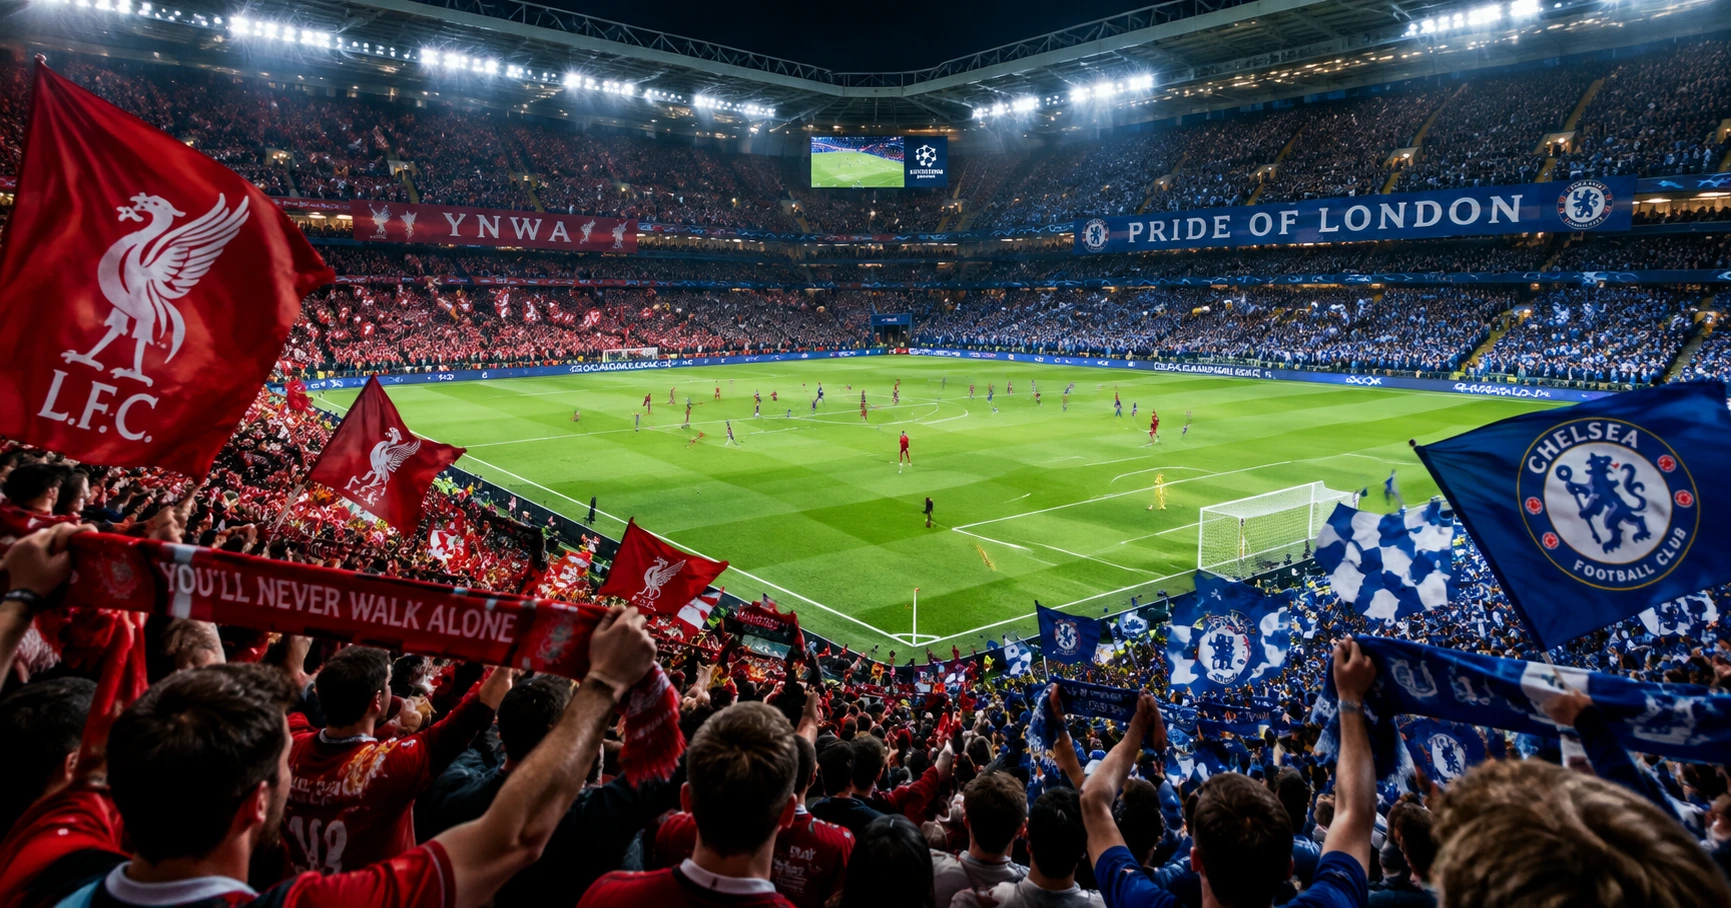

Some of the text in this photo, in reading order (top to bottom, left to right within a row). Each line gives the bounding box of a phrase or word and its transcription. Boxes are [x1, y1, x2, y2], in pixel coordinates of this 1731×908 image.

[443, 212, 572, 243] YNWA
[1128, 194, 1523, 243] PRIDE OF LONDON
[37, 369, 159, 443] L.F.C.
[1528, 422, 1638, 474] CHELSEA
[1573, 527, 1687, 582] FOOTBALL CLUB
[159, 562, 517, 643] YOU'LL NEVER WALK ALONE
